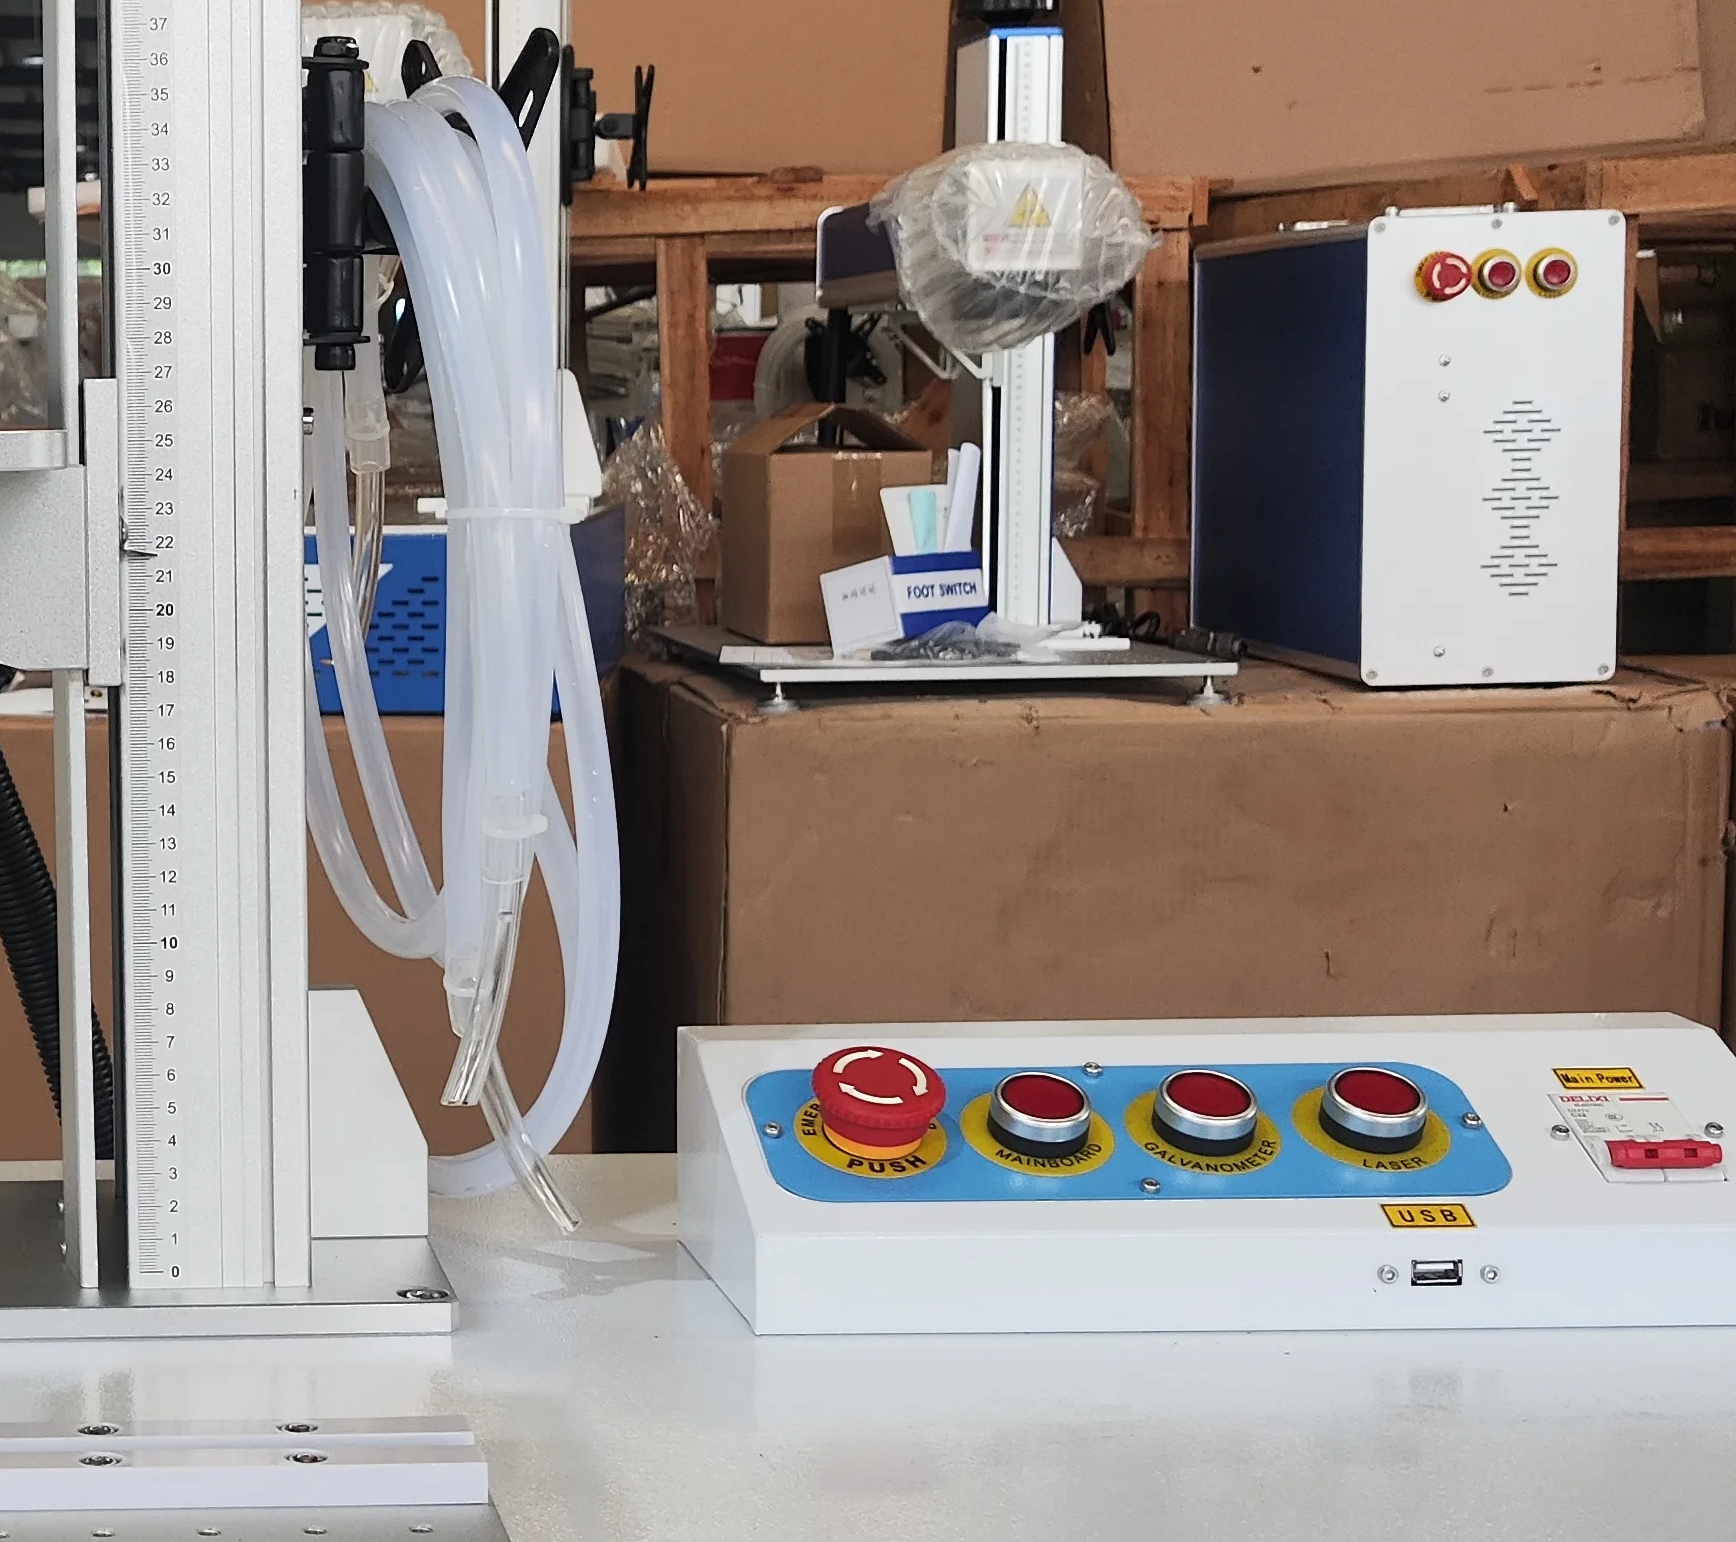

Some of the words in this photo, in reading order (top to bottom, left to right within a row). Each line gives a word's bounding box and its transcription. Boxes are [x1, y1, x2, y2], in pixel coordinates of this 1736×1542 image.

[149, 17, 168, 31] 37
[150, 52, 169, 66] 36
[150, 87, 169, 102] 35
[151, 122, 169, 137] 34
[151, 157, 170, 172] 33
[152, 192, 170, 206] 32
[152, 227, 169, 241] 31
[153, 262, 171, 276] 30
[153, 296, 172, 310] 29
[153, 330, 173, 345] 28
[154, 365, 173, 379] 27
[154, 399, 173, 413] 26
[155, 433, 174, 448] 25
[155, 467, 173, 482] 24
[155, 501, 174, 516] 23
[155, 535, 174, 549] 22
[155, 569, 172, 583] 21
[907, 584, 935, 600] FOOT
[939, 581, 977, 597] SWITCH
[156, 603, 174, 617] 20
[157, 636, 175, 650] 19
[157, 670, 175, 684] 18
[158, 703, 175, 717] 17
[158, 737, 175, 751] 16
[158, 770, 176, 784] 15
[159, 803, 176, 817] 14
[159, 836, 177, 850] 13
[160, 870, 177, 884] 12
[161, 903, 175, 916] 11
[160, 936, 178, 950] 10
[165, 969, 174, 983] 9
[165, 1002, 175, 1016] 8
[166, 1035, 175, 1049] 7
[167, 1068, 176, 1082] 6
[1561, 1073, 1594, 1083] Main
[1596, 1073, 1633, 1083] Power
[167, 1101, 177, 1115] 5
[167, 1134, 177, 1147] 4
[995, 1143, 1103, 1168] MAINBOARD
[1144, 1139, 1277, 1174] GALVANOMETER
[846, 1155, 927, 1174] PUSH
[1362, 1156, 1427, 1171] LASER
[169, 1166, 178, 1180] 3
[169, 1199, 179, 1213] 2
[171, 1232, 177, 1245] 1
[171, 1265, 180, 1278] 0
